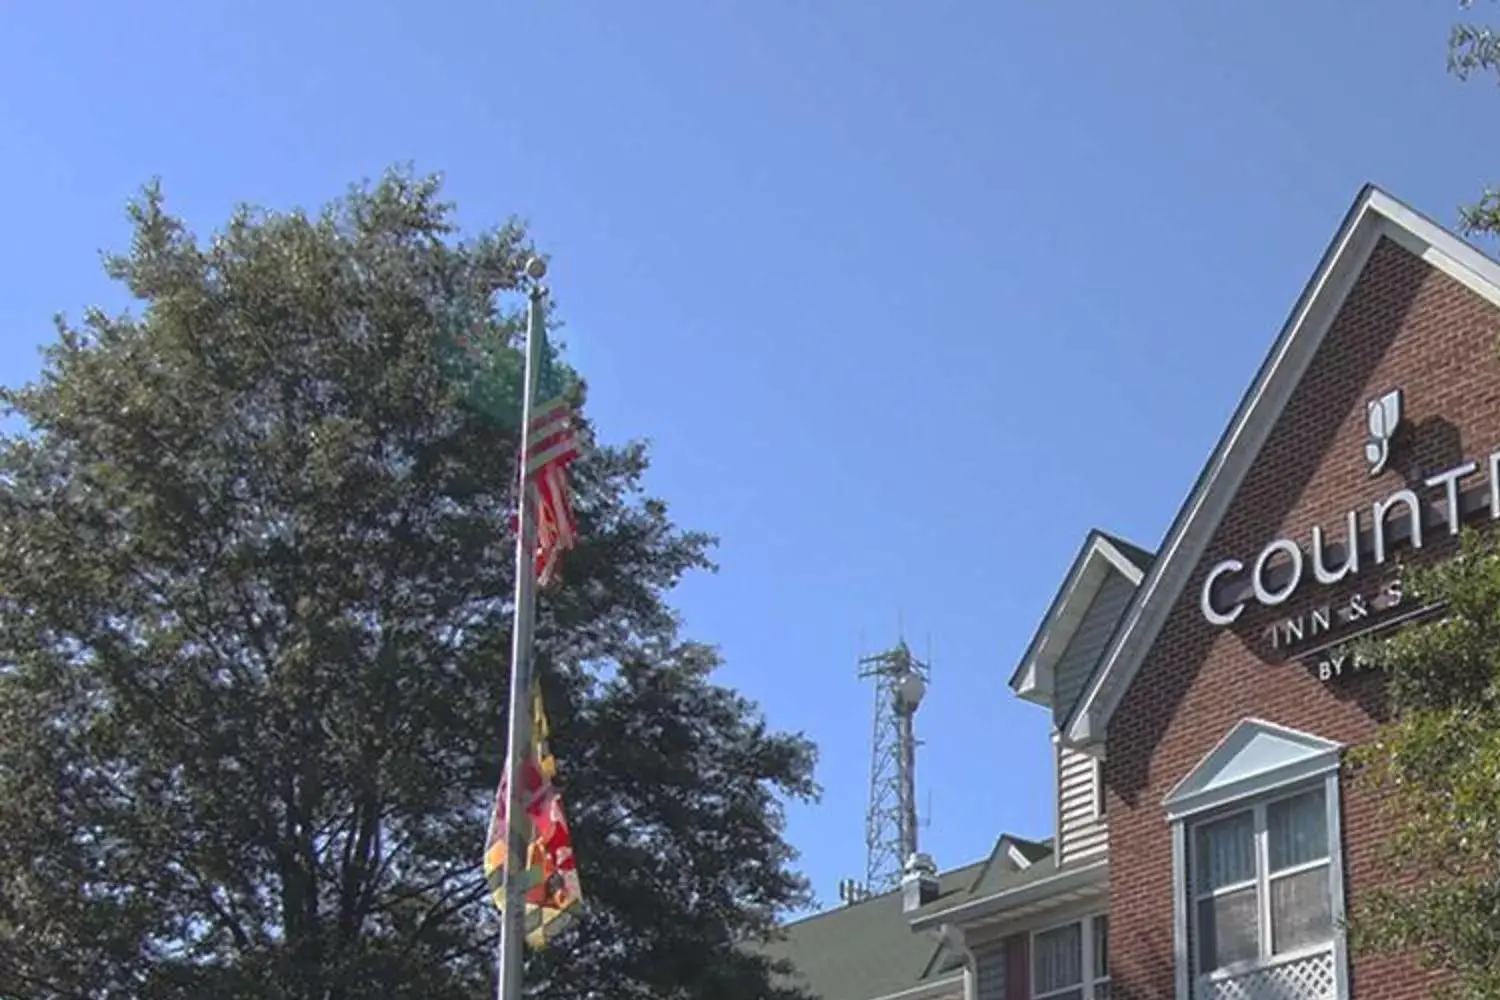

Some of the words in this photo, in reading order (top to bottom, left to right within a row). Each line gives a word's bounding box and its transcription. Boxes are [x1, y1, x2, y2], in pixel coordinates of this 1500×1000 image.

[1272, 605, 1331, 649] INN
[1348, 594, 1368, 621] &
[1318, 655, 1345, 681] BY
